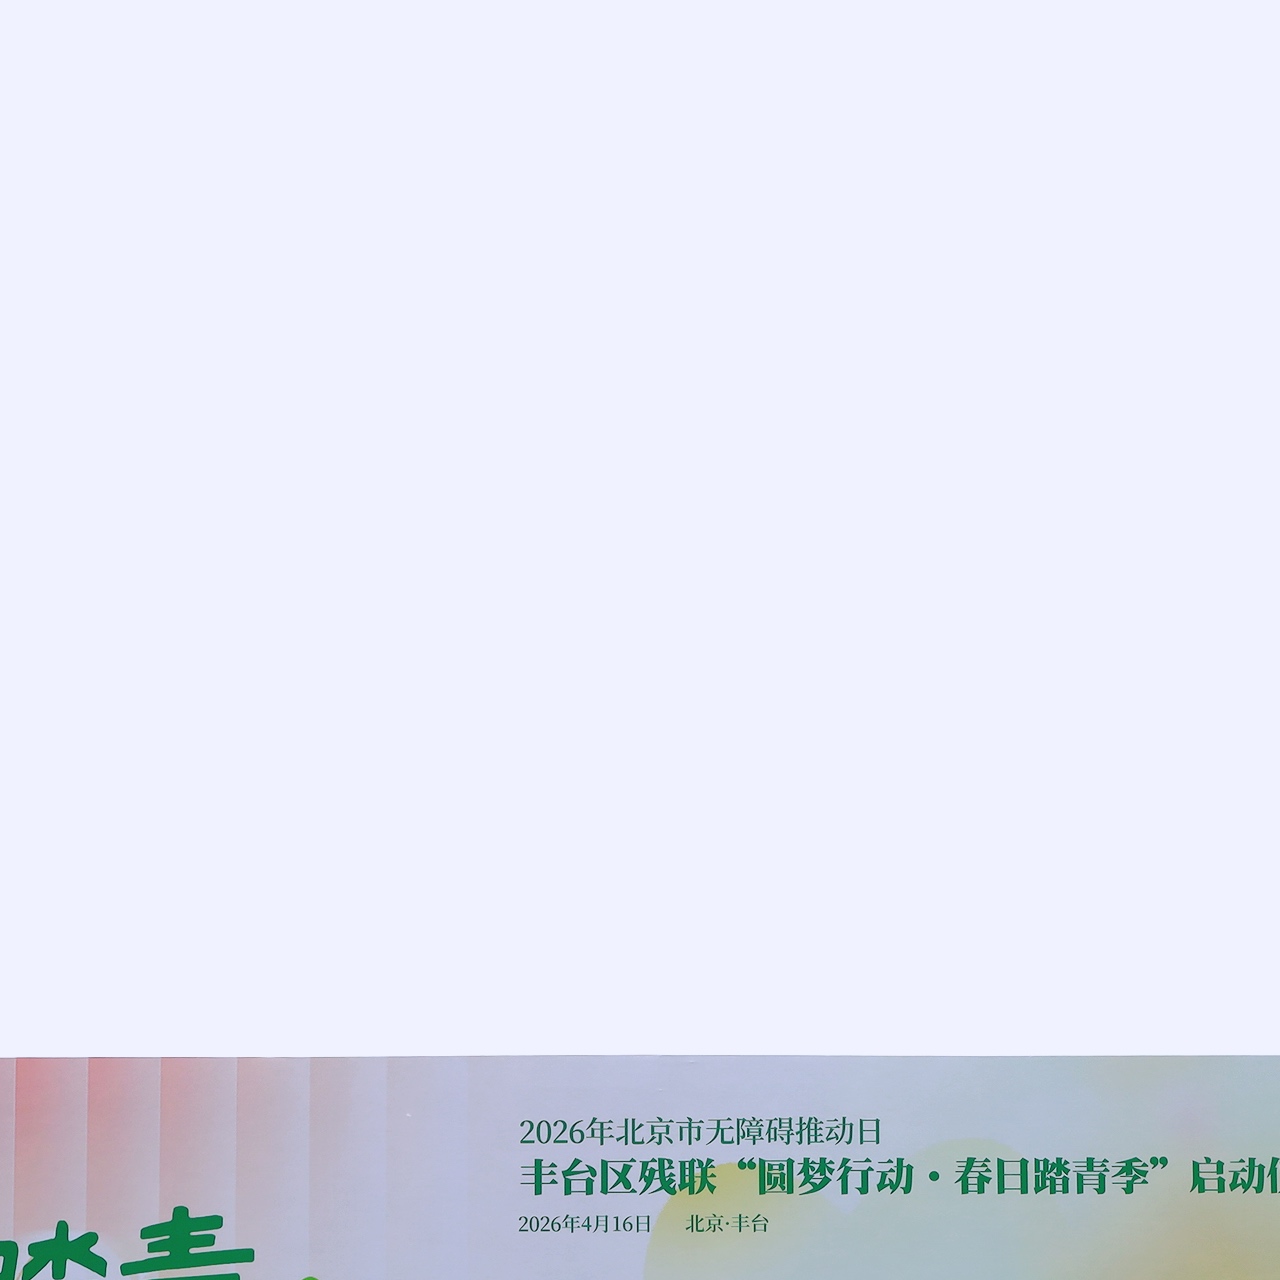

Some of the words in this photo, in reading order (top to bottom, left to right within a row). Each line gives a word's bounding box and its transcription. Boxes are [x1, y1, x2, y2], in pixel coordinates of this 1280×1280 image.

[519, 1115, 882, 1147] 2026年北京市无障碍推动日
[518, 1213, 652, 1235] 2026年4月16日
[685, 1212, 769, 1234] 北京·丰台
